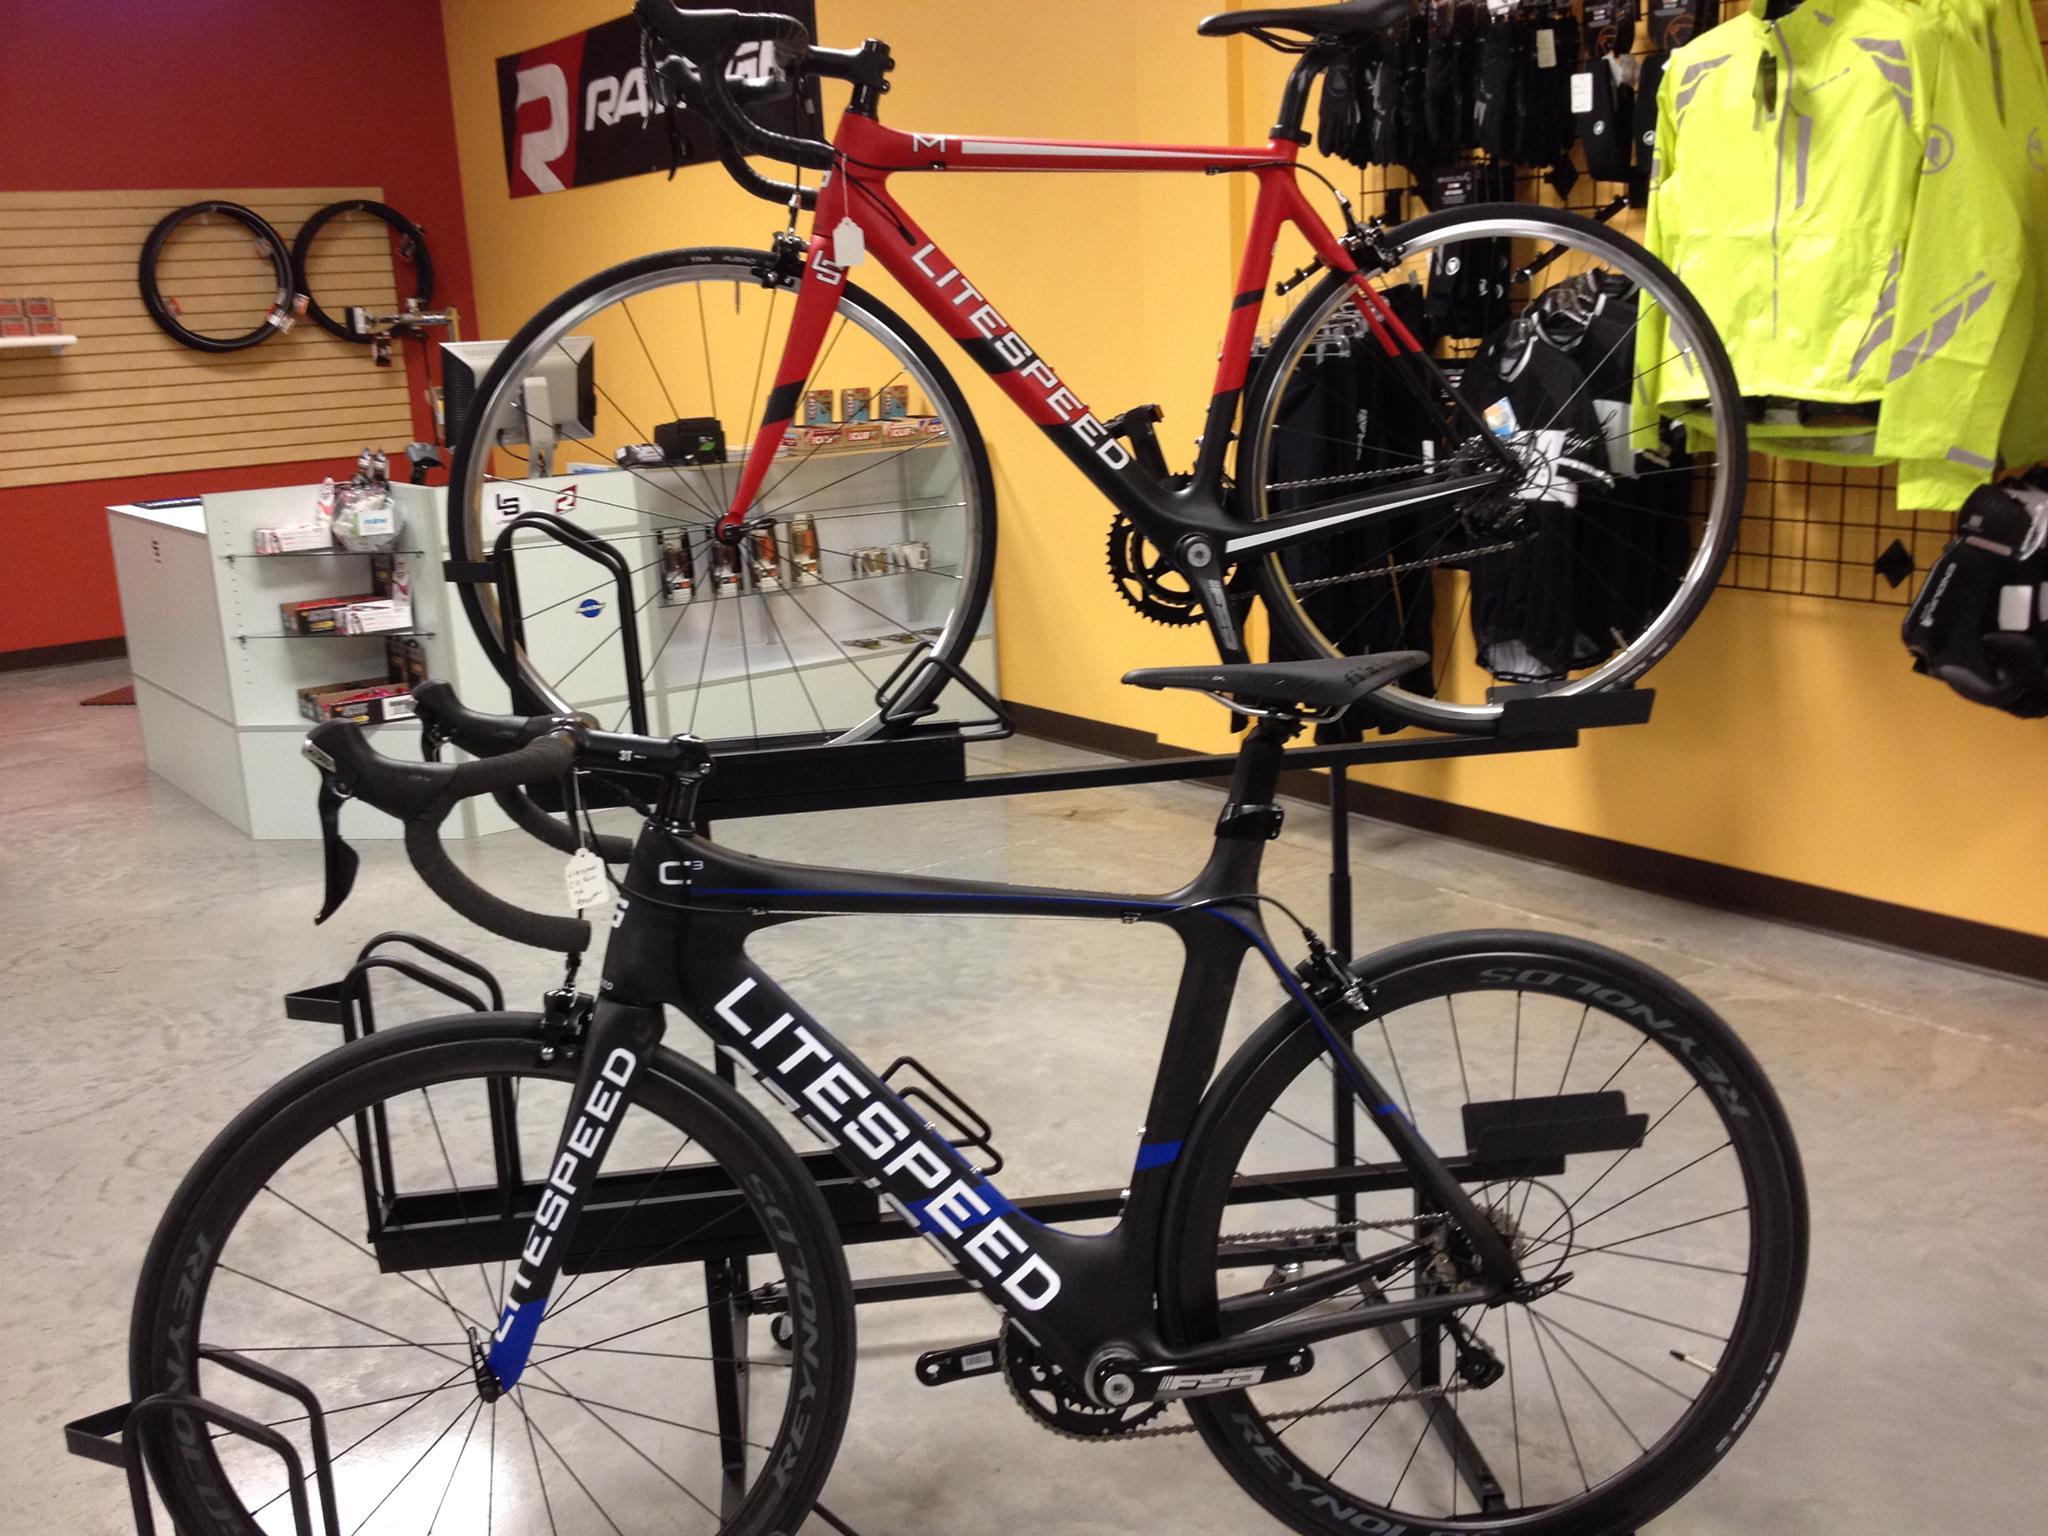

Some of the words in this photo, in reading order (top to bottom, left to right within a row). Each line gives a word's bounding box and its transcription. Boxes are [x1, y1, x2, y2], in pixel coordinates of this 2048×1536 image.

[911, 243, 1130, 470] LITESPEED
[713, 977, 1061, 1311] LITESPEED
[1478, 967, 1751, 1118] REYNOLDS
